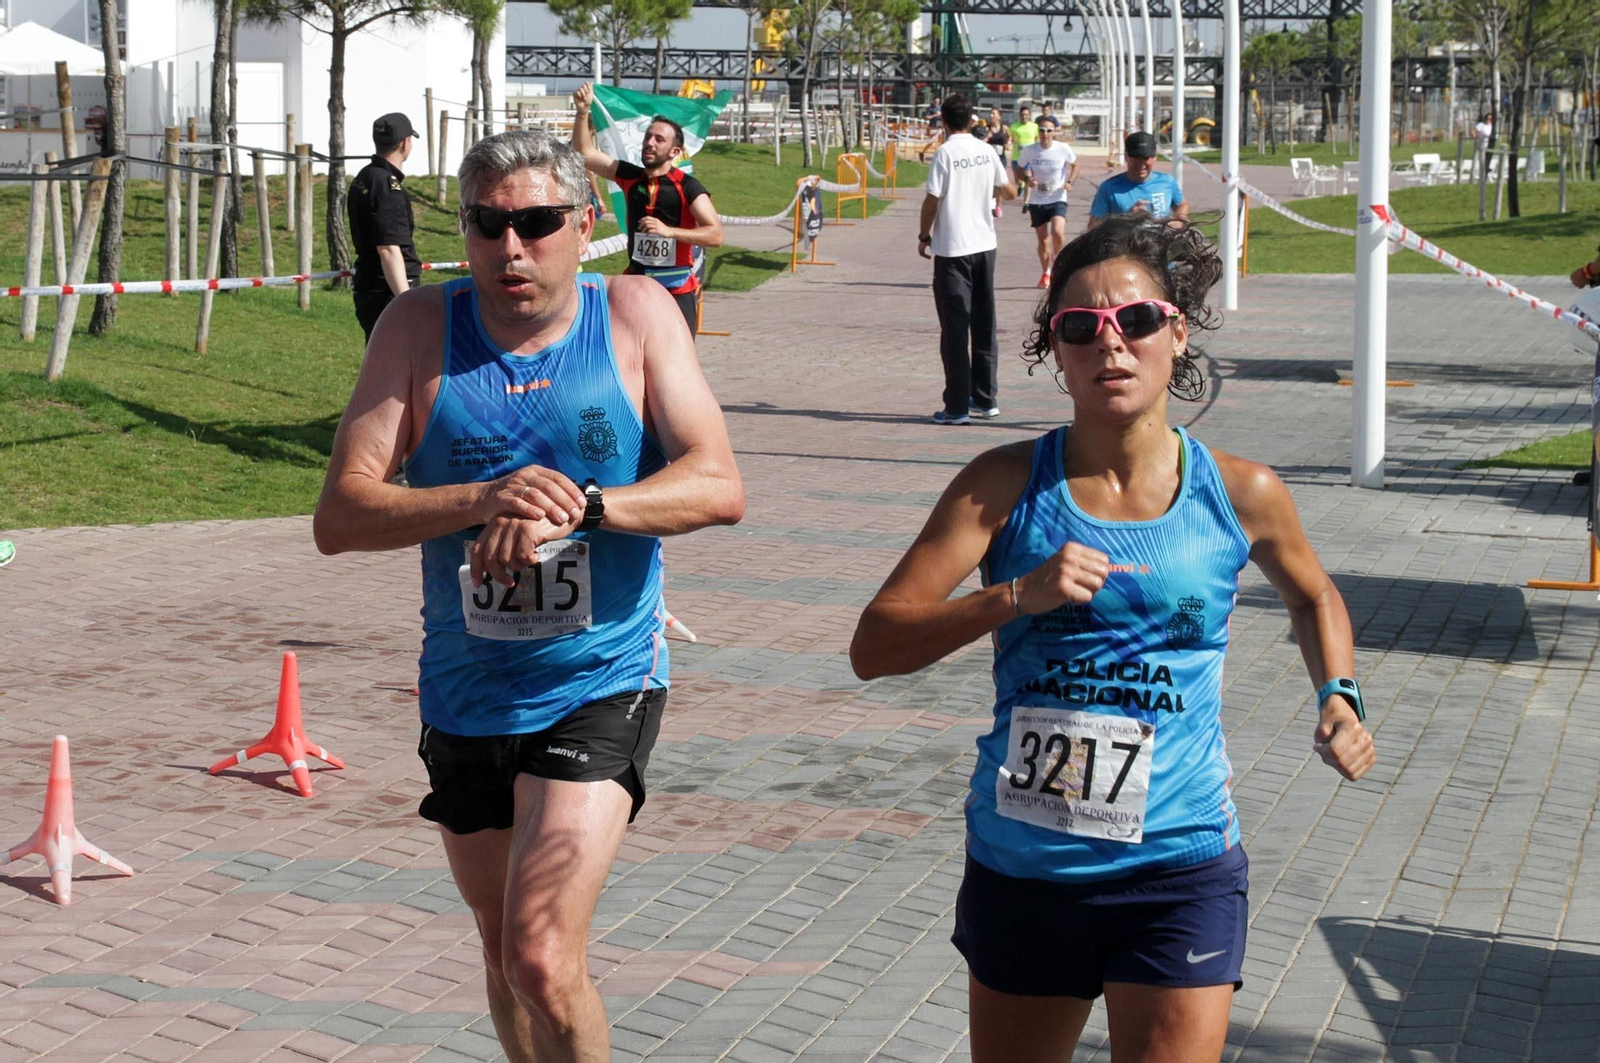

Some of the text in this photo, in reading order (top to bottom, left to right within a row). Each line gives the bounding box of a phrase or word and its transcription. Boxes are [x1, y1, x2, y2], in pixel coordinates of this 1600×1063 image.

[953, 155, 991, 170] POLICIA
[637, 239, 669, 257] 4268
[450, 435, 508, 447] JEFATURA
[452, 445, 508, 456] SUPERIOR
[447, 459, 461, 468] DE
[472, 560, 579, 612] 3215
[531, 613, 588, 624] DEPORTIVA
[517, 628, 533, 636] 3215
[1096, 723, 1106, 731] LA
[1009, 731, 1141, 804] 3217
[1074, 806, 1140, 823] DEPORTIVA
